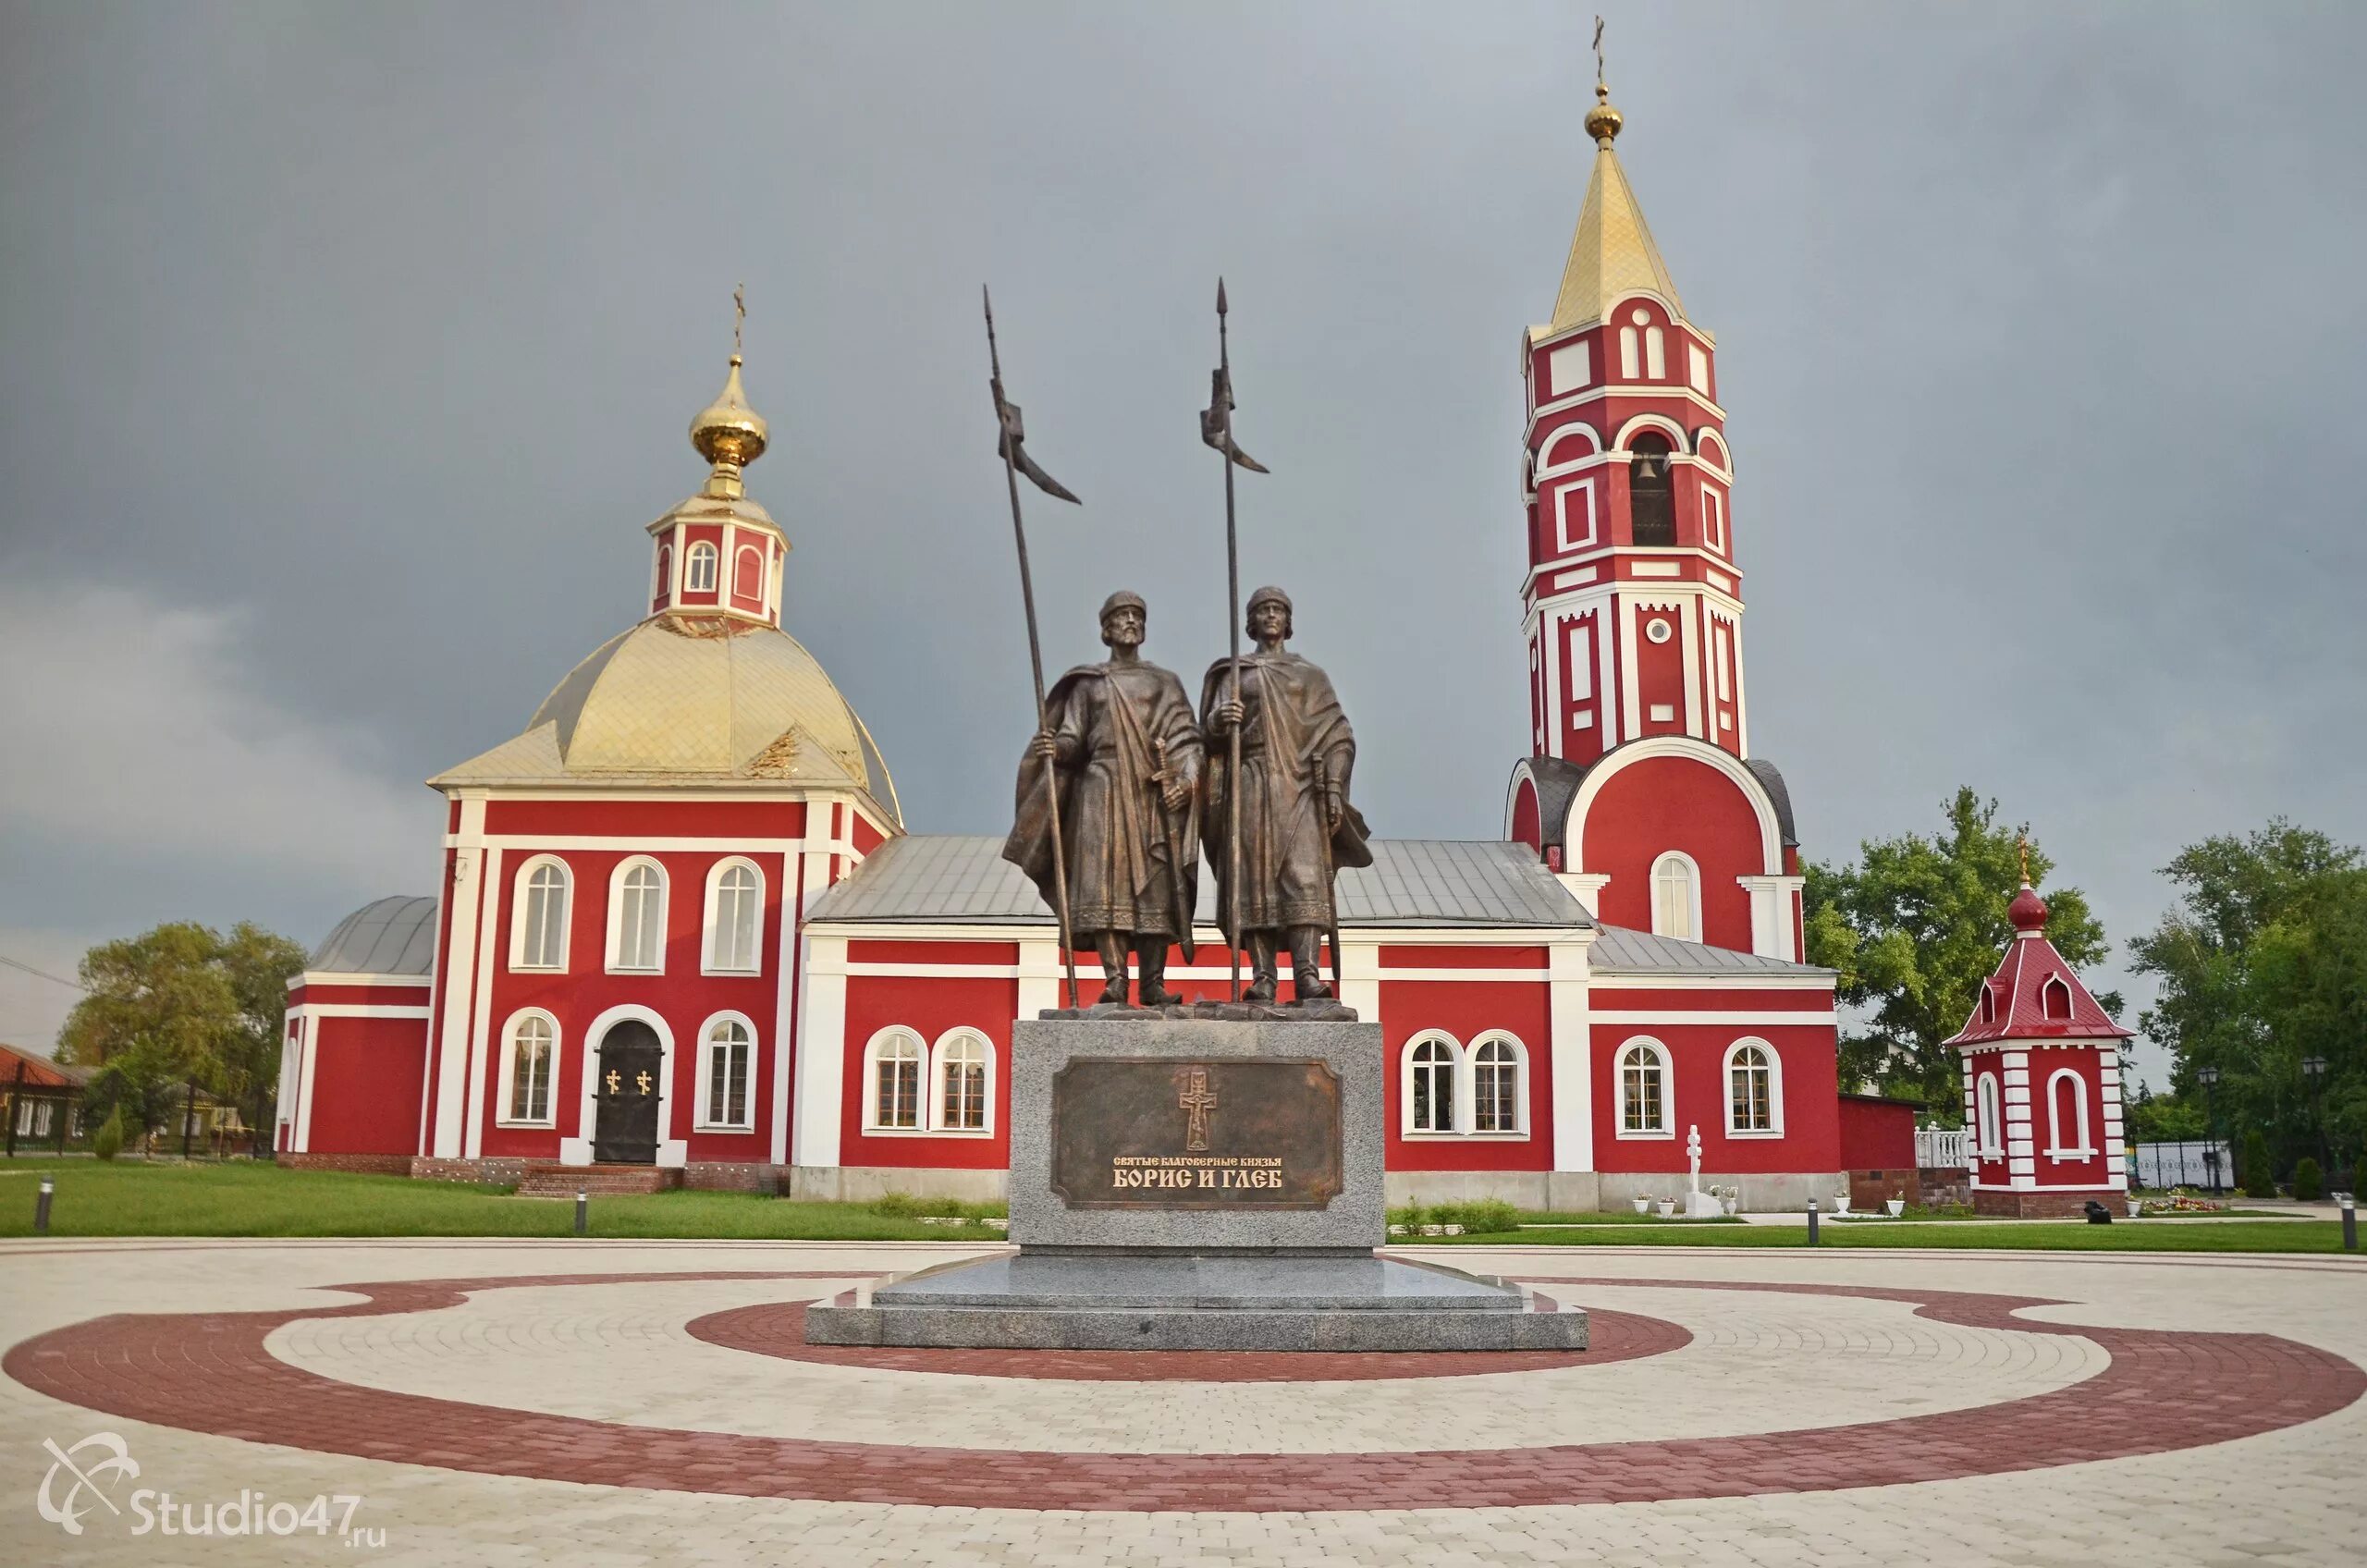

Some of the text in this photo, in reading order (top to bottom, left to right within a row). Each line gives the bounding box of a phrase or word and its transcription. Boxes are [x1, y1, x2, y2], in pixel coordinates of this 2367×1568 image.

[1113, 1157, 1282, 1167] СВЯТЫЕ БЛАГОВЕРНЫЕ КНЯЗЬЯ
[1112, 1169, 1282, 1188] БОРИС И ГЛЕБ
